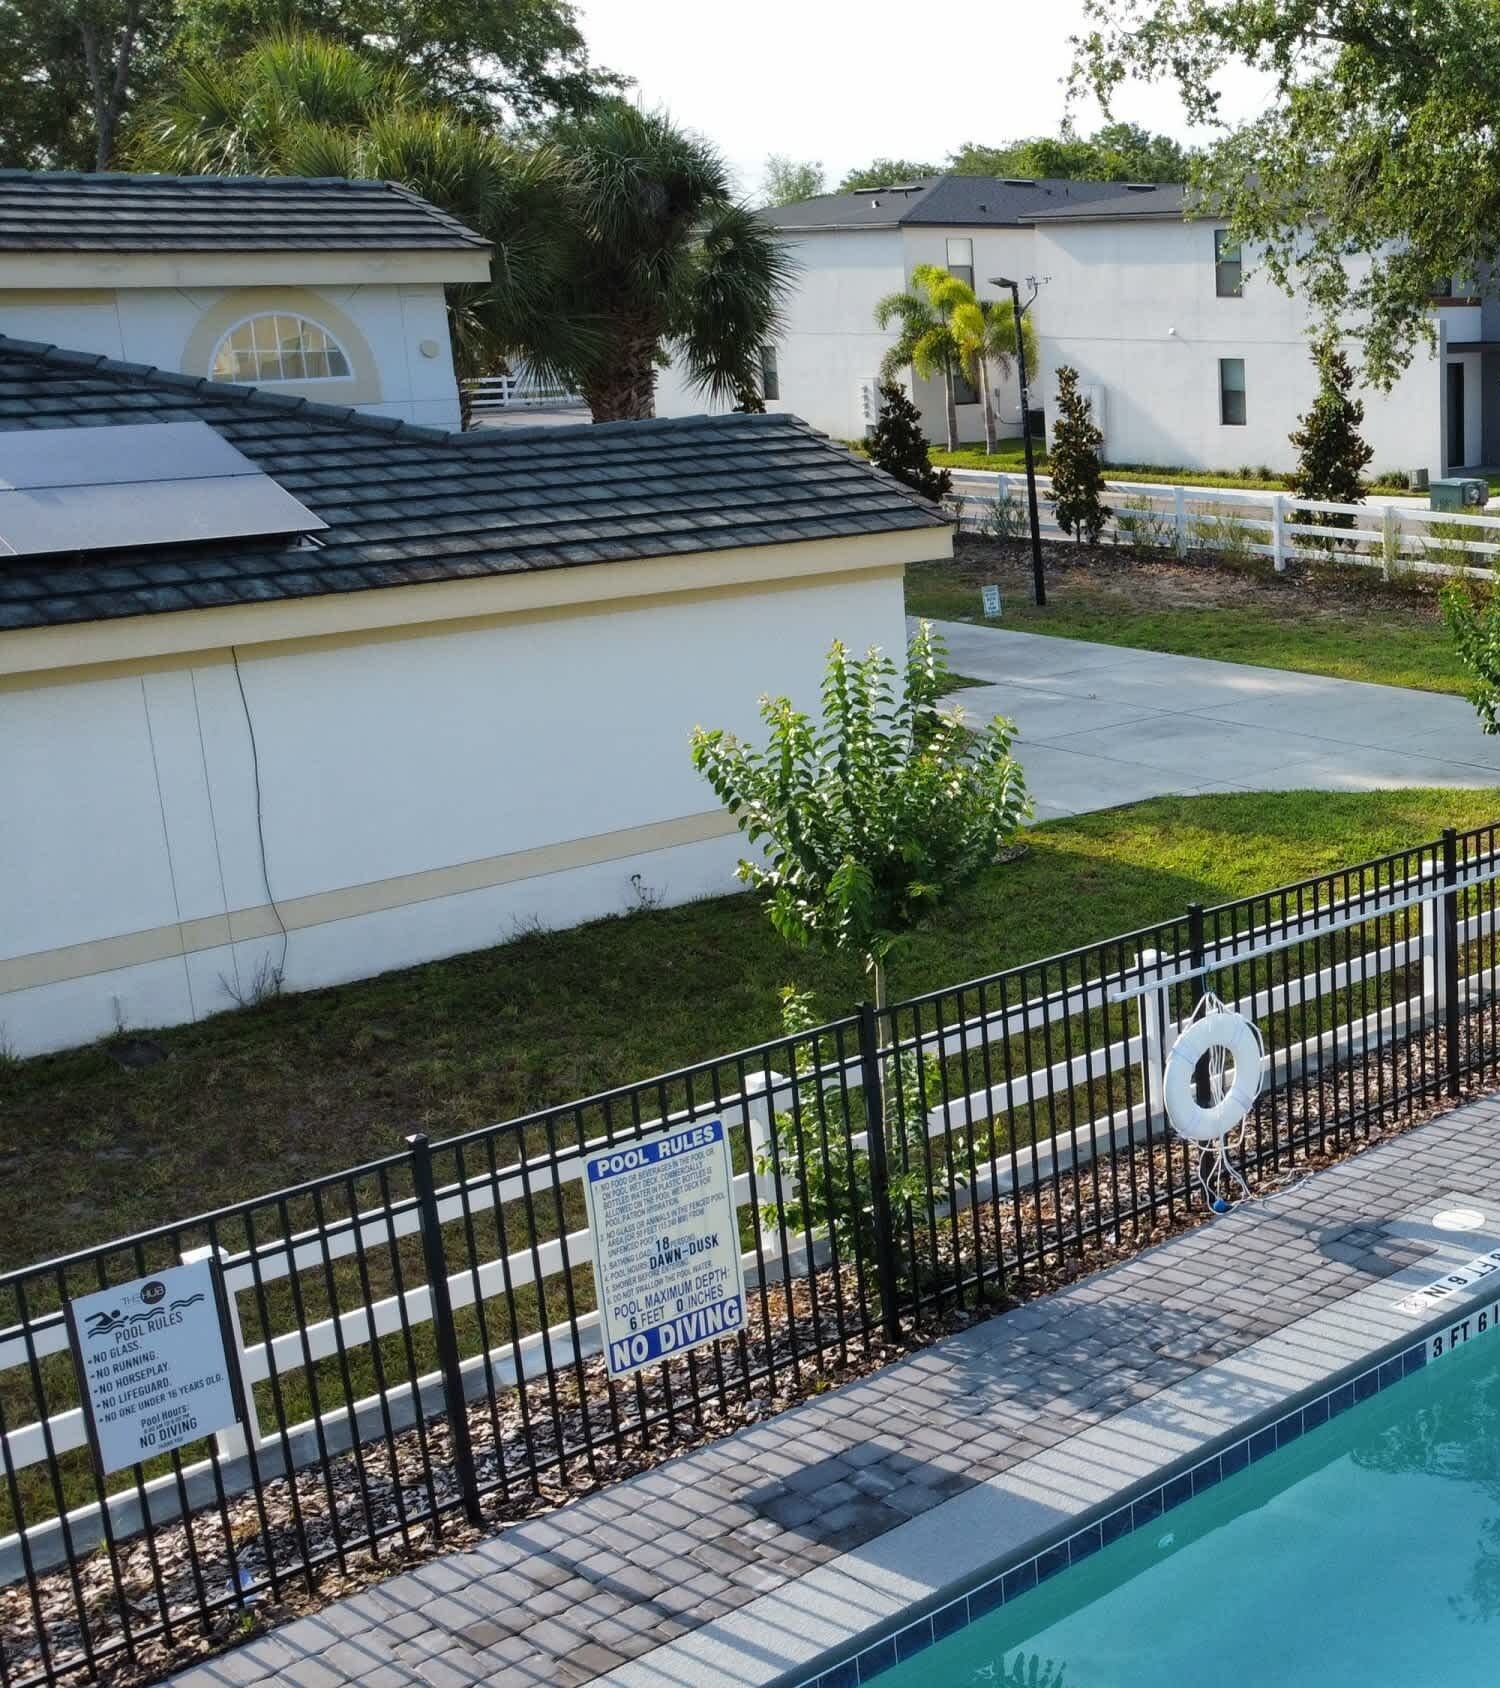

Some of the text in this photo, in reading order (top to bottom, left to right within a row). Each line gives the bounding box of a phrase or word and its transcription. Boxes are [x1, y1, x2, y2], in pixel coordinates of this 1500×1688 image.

[597, 1125, 715, 1177] POOL RULES
[600, 1182, 609, 1192] NO
[611, 1176, 627, 1189] FOOD
[638, 1161, 672, 1179] BEVERAGES
[679, 1155, 689, 1165] THE
[690, 1150, 704, 1162] POOL
[705, 1147, 713, 1156] OR
[602, 1191, 611, 1201] ON
[612, 1186, 627, 1198] POOL
[629, 1181, 641, 1192] WET
[660, 1160, 702, 1181] COMMERCIALLY
[603, 1194, 629, 1210] BOTTLED
[630, 1187, 650, 1200] WATER
[658, 1176, 681, 1191] PLASTIC
[682, 1168, 706, 1183] BOTTLES
[604, 1203, 633, 1219] ALLOWED
[633, 1199, 642, 1209] ON
[643, 1195, 653, 1205] THE
[655, 1189, 670, 1201] POOL
[684, 1180, 698, 1191] DECK
[699, 1175, 710, 1185] FOR
[605, 1216, 621, 1228] POOL
[622, 1208, 645, 1222] PATRON
[606, 1230, 615, 1239] NO
[616, 1223, 635, 1236] GLASS
[636, 1219, 644, 1229] OR
[646, 1210, 669, 1225] ANIMALS
[677, 1204, 687, 1214] THE
[689, 1196, 709, 1210] FENCED
[710, 1191, 724, 1202] POOL
[607, 1236, 623, 1248] AREA
[643, 1224, 657, 1235] FEET
[609, 1254, 634, 1270] BATHING
[655, 1236, 670, 1252] 18
[610, 1268, 626, 1280] POOL
[649, 1233, 719, 1270] DAWN-DUSK
[612, 1277, 636, 1293] SHOWER
[637, 1268, 660, 1283] BEFORE
[613, 1293, 622, 1303] DO
[623, 1289, 633, 1299] NOT
[636, 1278, 663, 1294] SWALLOW
[664, 1273, 675, 1283] THE
[676, 1267, 690, 1279] POOL
[614, 1266, 728, 1320] POOL MAXIMUM DEPTH
[1448, 1275, 1468, 1285] 6
[630, 1284, 724, 1330] 6 FEET 0 INCHES
[115, 1311, 184, 1344] POOL RULES
[612, 1298, 740, 1371] NO DIVING
[1433, 1336, 1442, 1358] 3
[1478, 1312, 1487, 1333] 6
[93, 1340, 142, 1364] NO GLASS.
[96, 1351, 159, 1380] NO RUNNING.
[99, 1382, 113, 1395] NO
[102, 1396, 116, 1409] NO
[105, 1373, 224, 1424] NO ONE UNDER 16 YEARS OLD.
[139, 1432, 156, 1449] NO
[159, 1417, 198, 1443] DIVING
[140, 1412, 160, 1428] Pool
